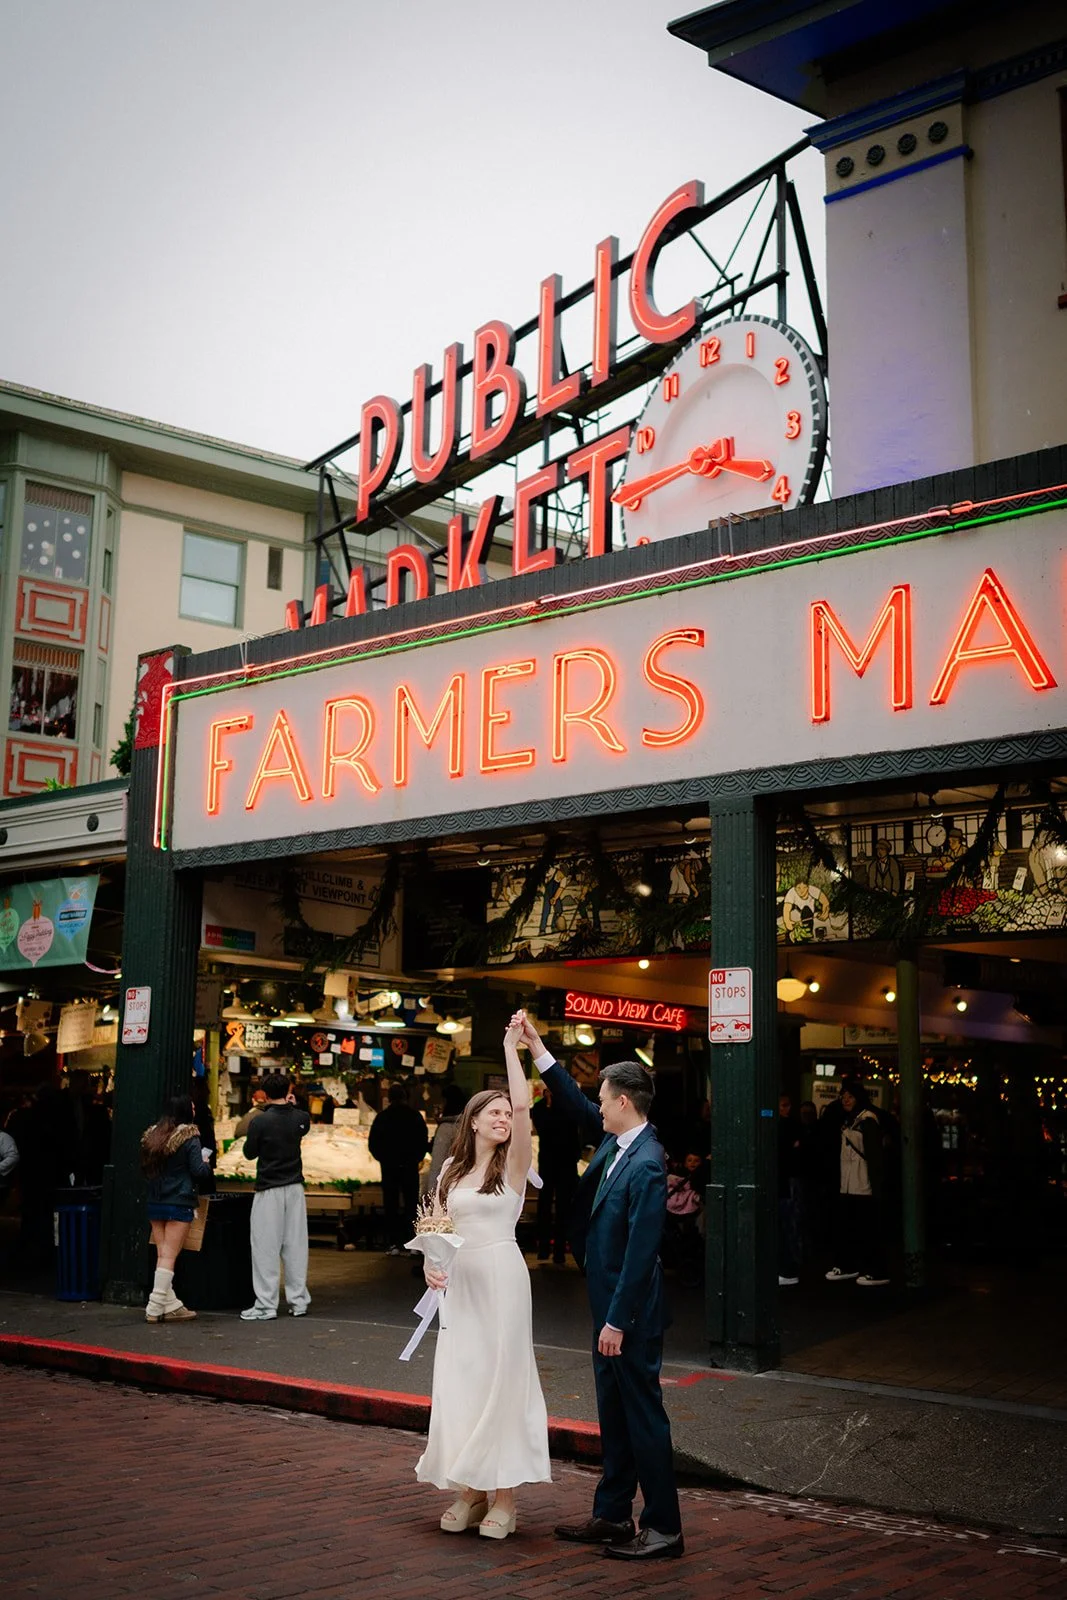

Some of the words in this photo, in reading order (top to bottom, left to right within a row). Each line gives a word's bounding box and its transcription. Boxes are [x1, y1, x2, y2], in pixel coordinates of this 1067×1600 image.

[356, 179, 706, 524] PUBLIC
[700, 337, 721, 367] 12
[746, 331, 755, 358] 1
[775, 358, 790, 386] 2
[664, 373, 679, 402] 11
[785, 410, 802, 440] 3
[637, 426, 655, 454] 10
[771, 475, 792, 503] 4
[206, 628, 706, 816] FARMERS
[312, 884, 366, 905] VIEWPOINT
[712, 973, 724, 983] NO
[128, 1001, 147, 1011] STOPS
[715, 986, 746, 999] STOPS
[564, 992, 614, 1016] SOUND
[617, 998, 649, 1019] VIEW
[652, 1003, 685, 1024] CAFE
[245, 1023, 273, 1033] PLACE
[245, 1040, 281, 1048] MARKET
